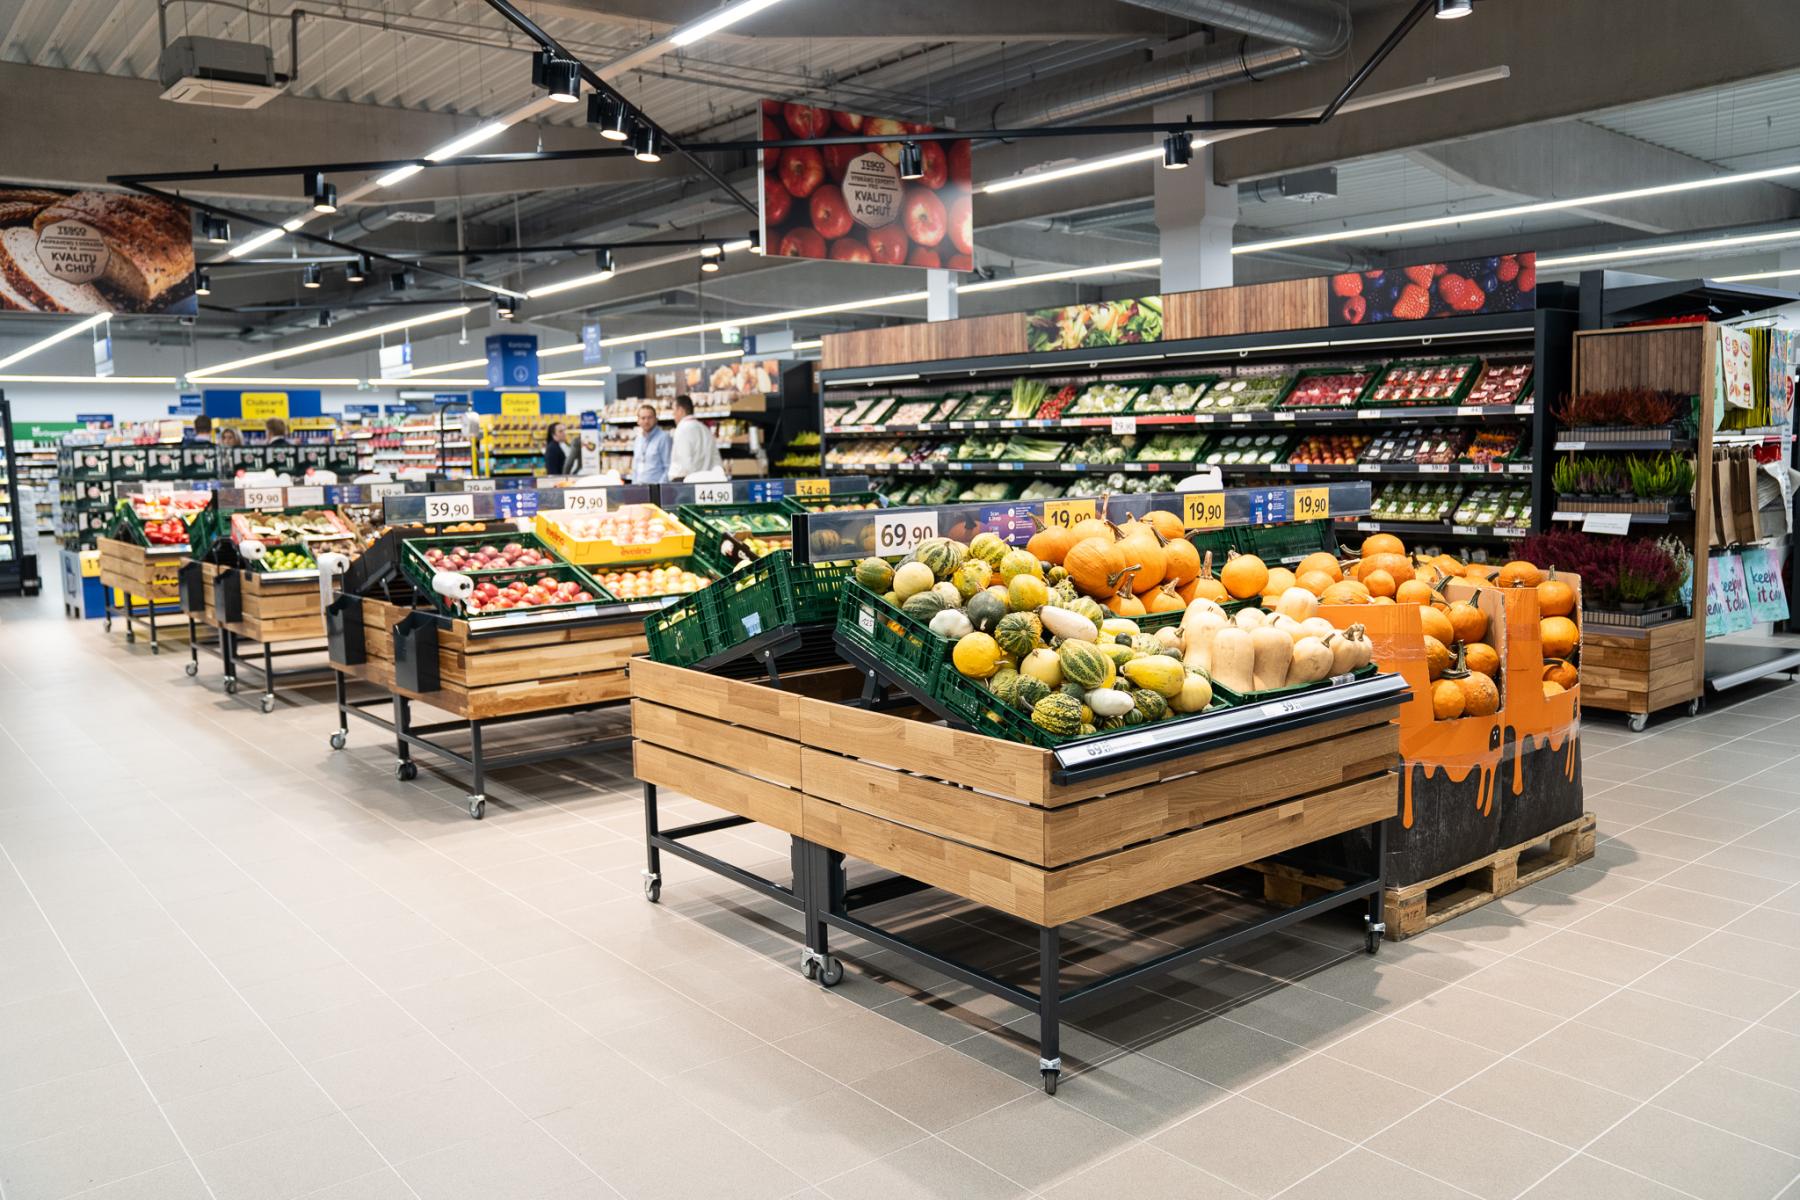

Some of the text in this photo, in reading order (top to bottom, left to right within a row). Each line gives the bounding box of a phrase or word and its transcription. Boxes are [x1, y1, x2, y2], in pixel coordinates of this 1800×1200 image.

[861, 160, 885, 172] TESCO
[855, 190, 892, 204] KVALITU
[857, 204, 864, 214] A
[57, 226, 87, 236] TESCO
[51, 252, 96, 263] KVALITU
[55, 263, 62, 272] A
[569, 495, 603, 510] 79,90
[700, 490, 729, 503] 44,90
[430, 502, 470, 518] 39,90
[1299, 495, 1327, 515] 19,90
[1189, 501, 1222, 523] 19,90
[881, 523, 933, 549] 69,90
[1087, 743, 1103, 756] 69
